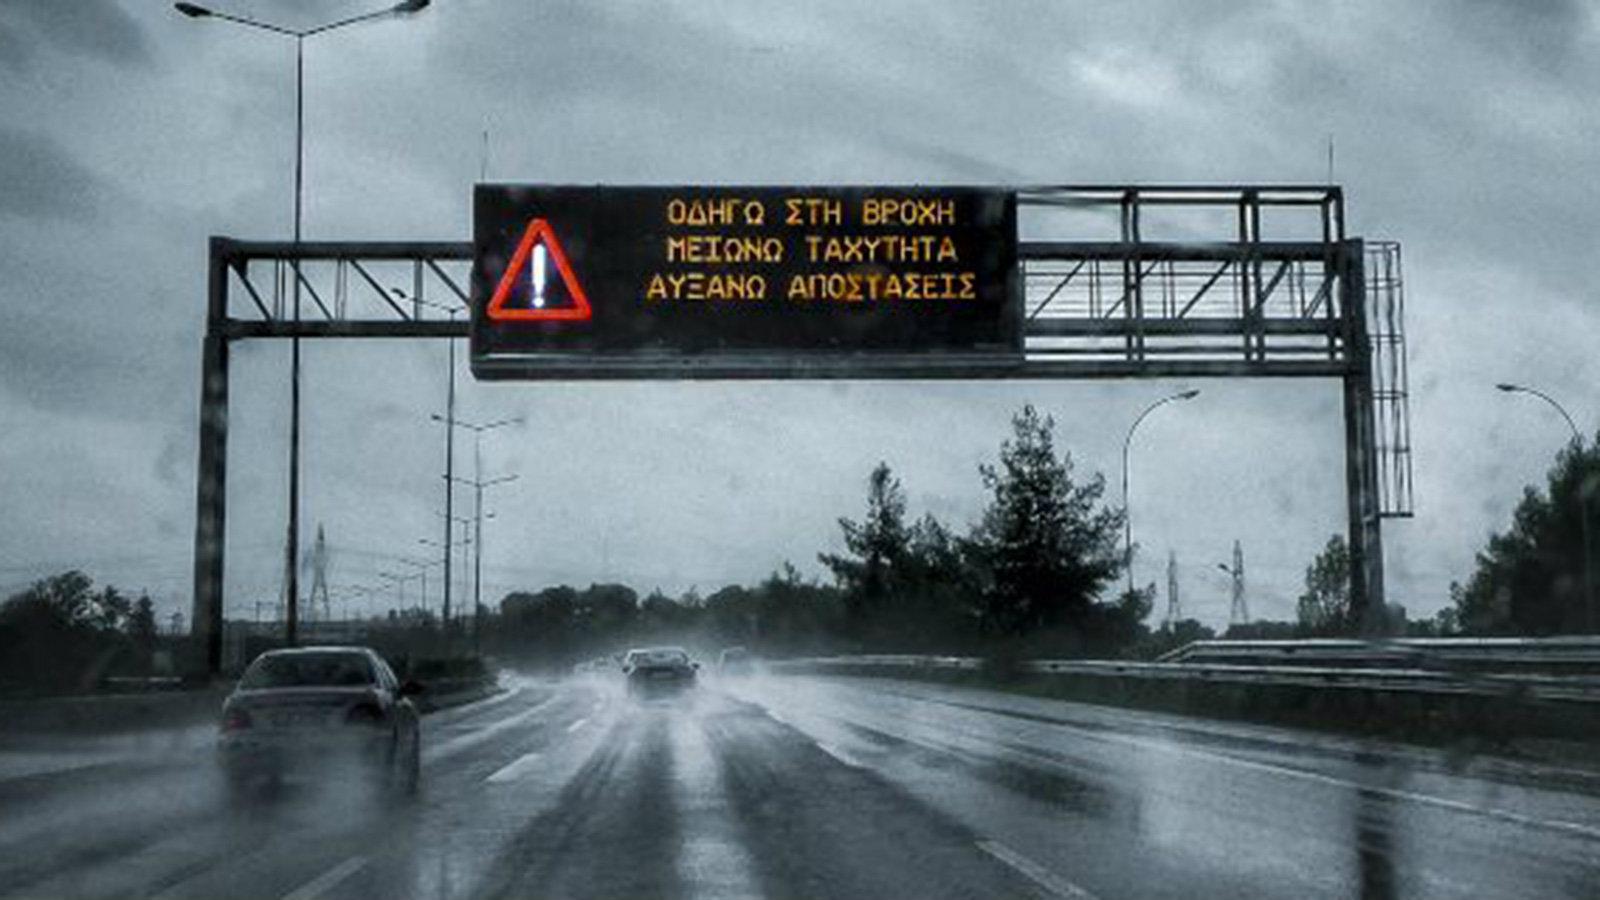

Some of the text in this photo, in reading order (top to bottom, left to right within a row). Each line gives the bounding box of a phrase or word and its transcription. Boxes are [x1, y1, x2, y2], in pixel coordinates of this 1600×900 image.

[667, 198, 956, 226] ΟΔΗΓΩ ΣΤΗ ΒΡΟΧΗ
[667, 235, 959, 263] ΜΕΙΩΝΩ ΤΑΧΥΤΗΤΑ
[647, 273, 976, 301] ΑΥΞΑΝΩ ΑΠΟΣΤΑΣΕΙΣ
